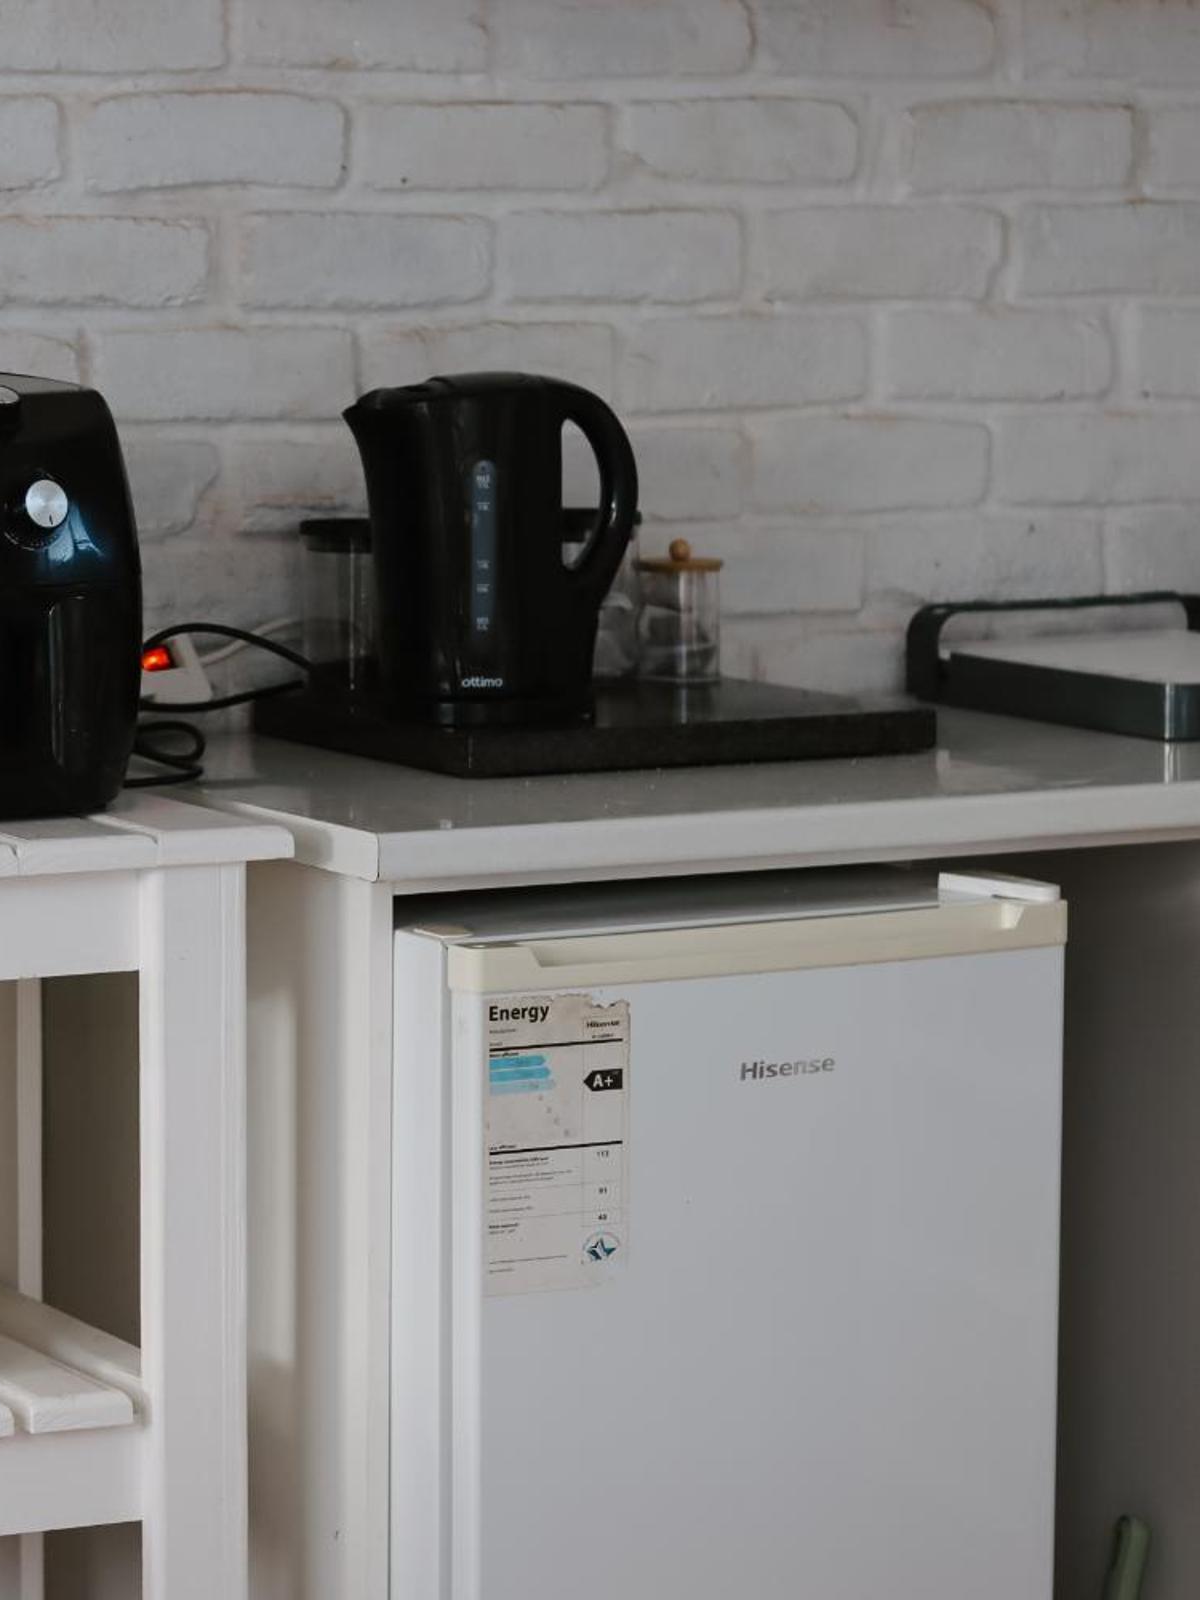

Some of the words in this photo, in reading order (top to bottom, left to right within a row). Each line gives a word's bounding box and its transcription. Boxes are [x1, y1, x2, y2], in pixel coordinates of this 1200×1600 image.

[461, 676, 504, 688] ottimo
[489, 1005, 550, 1023] Energy
[740, 1057, 836, 1081] Hisense
[592, 1073, 614, 1089] A+
